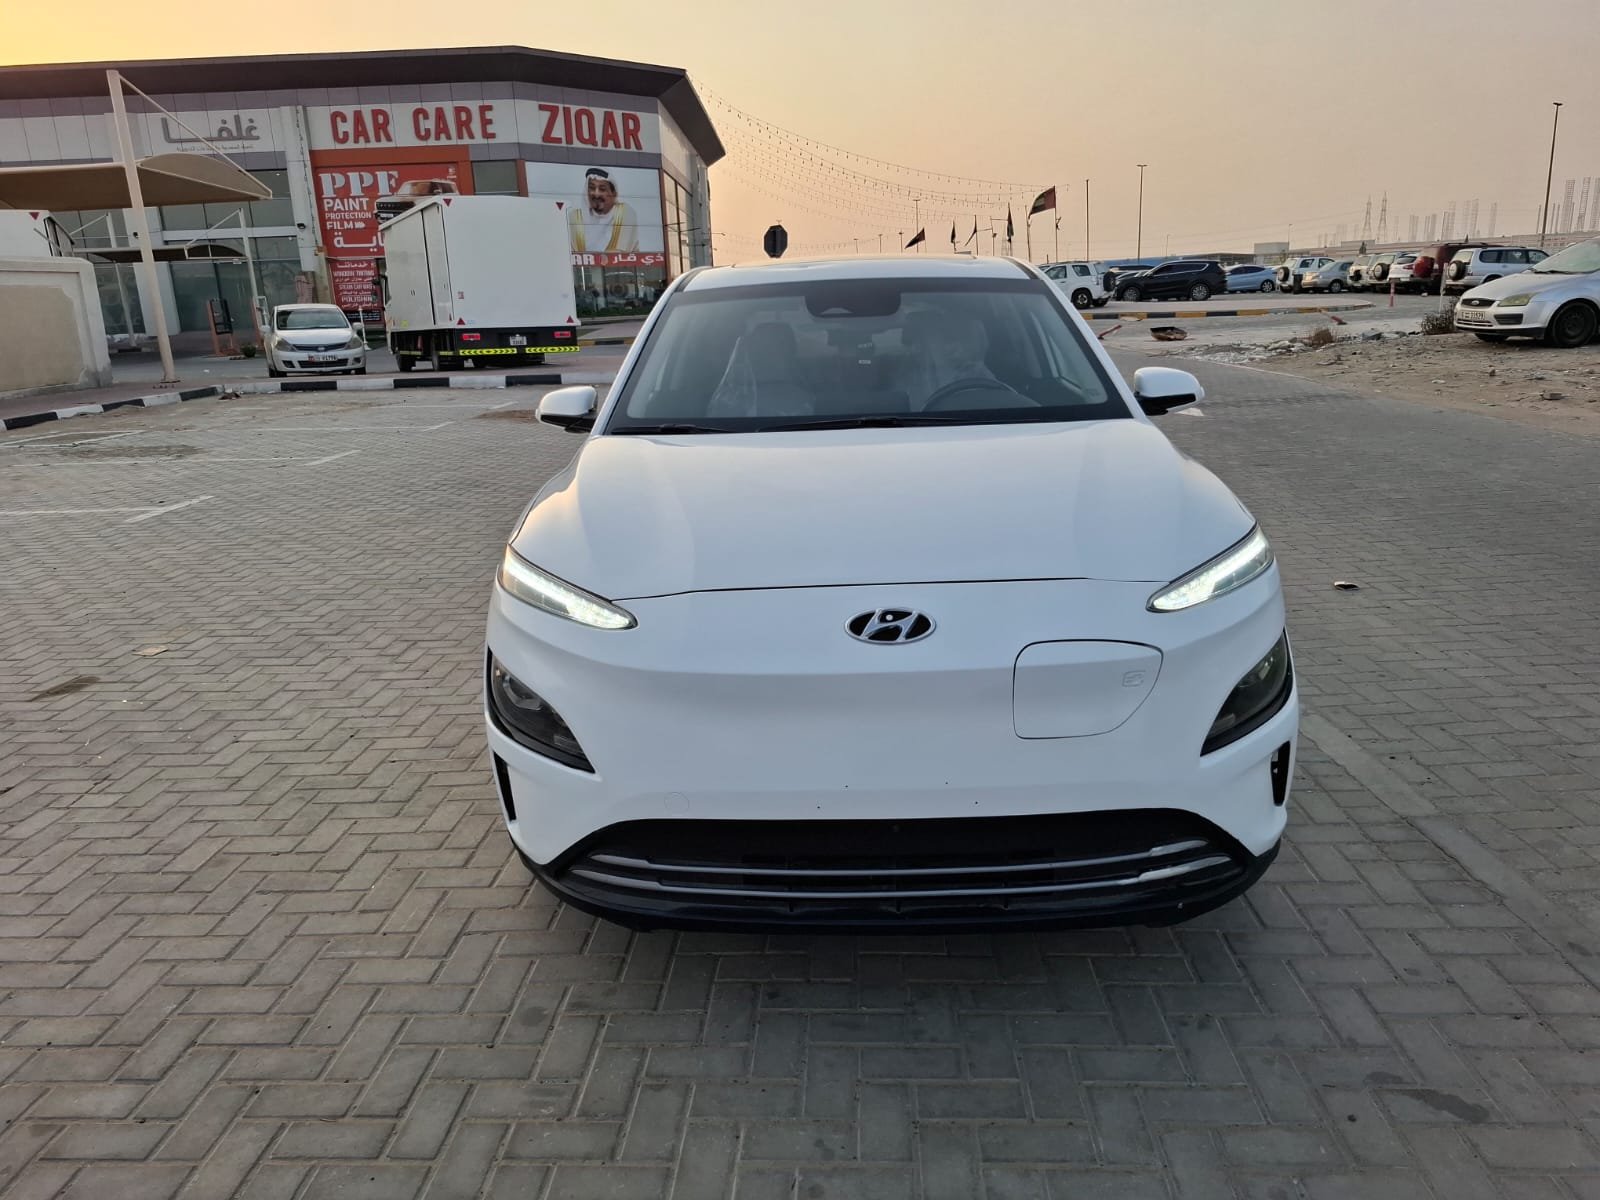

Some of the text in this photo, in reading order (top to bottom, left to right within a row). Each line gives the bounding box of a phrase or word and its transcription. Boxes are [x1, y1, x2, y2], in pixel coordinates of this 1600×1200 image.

[330, 103, 643, 150] CAR CARE ZIQAR
[318, 171, 399, 198] PPF
[323, 197, 370, 212] PAINT
[325, 211, 372, 220] PROTECTION
[326, 221, 354, 231] FILM
